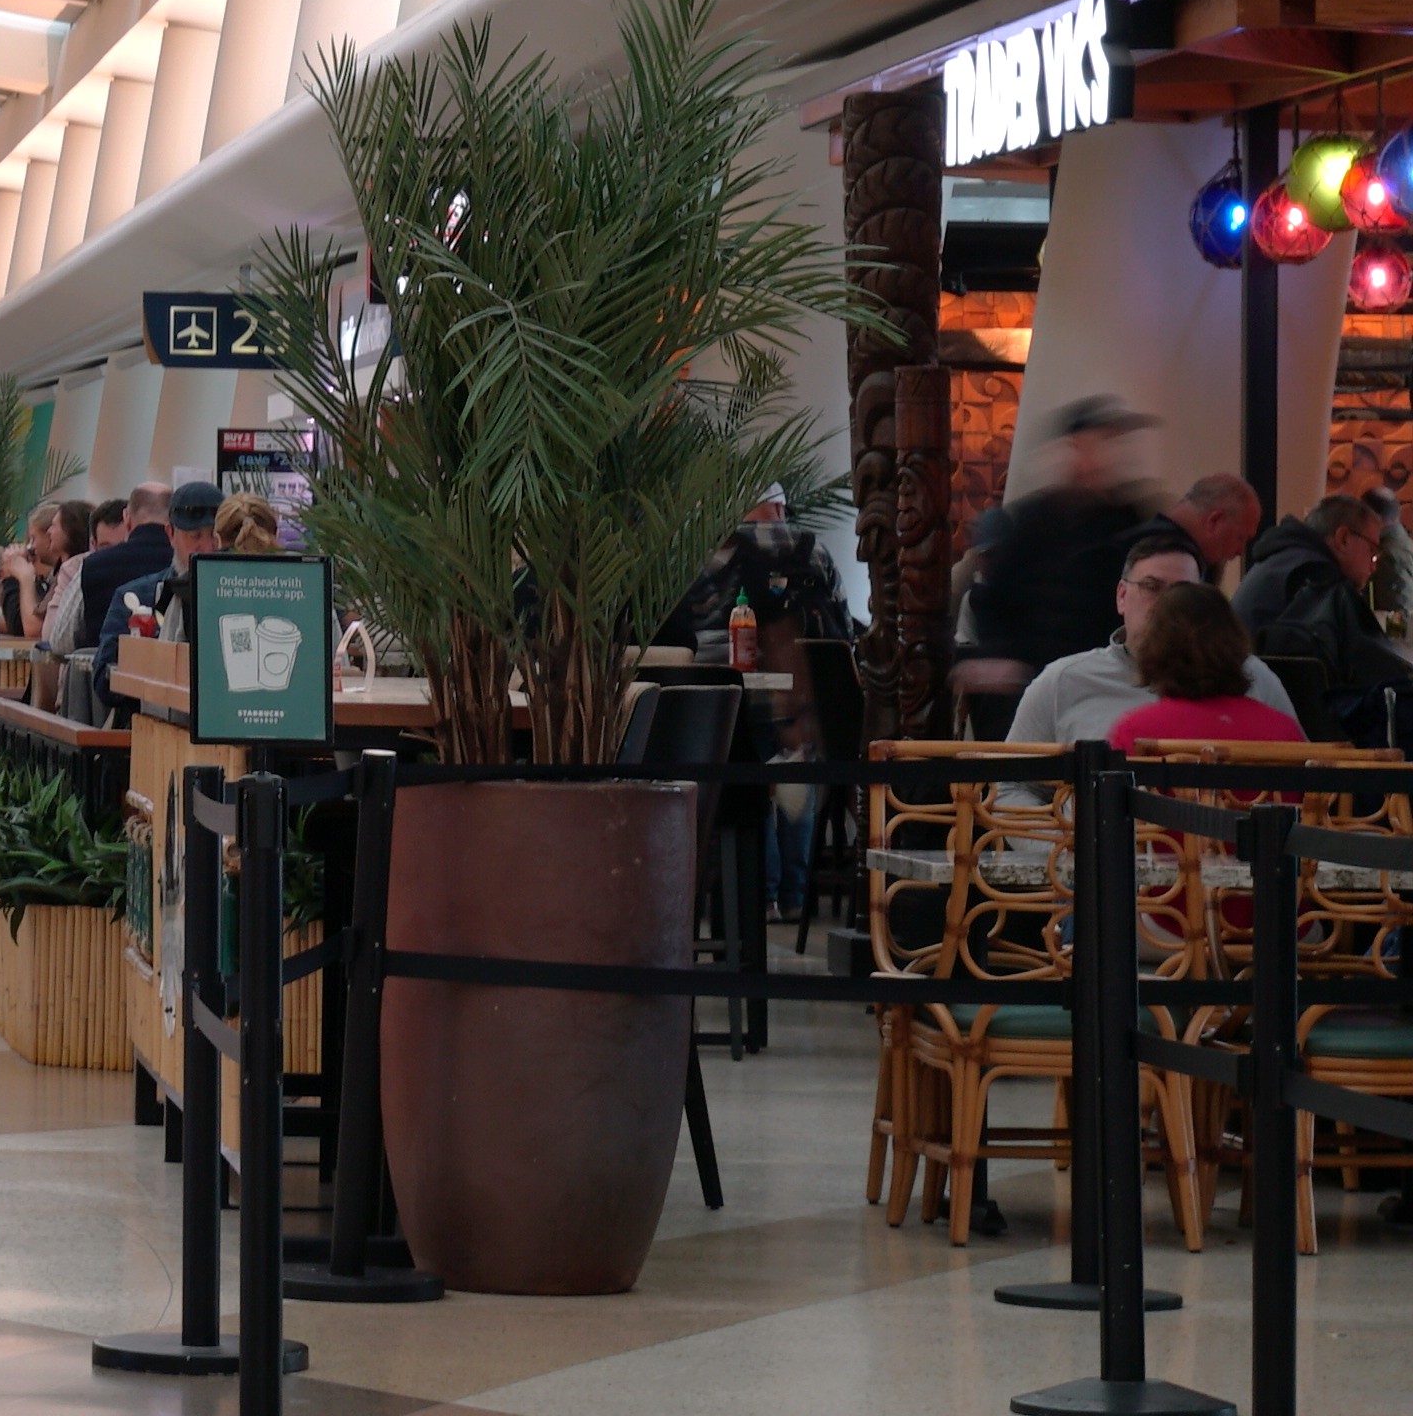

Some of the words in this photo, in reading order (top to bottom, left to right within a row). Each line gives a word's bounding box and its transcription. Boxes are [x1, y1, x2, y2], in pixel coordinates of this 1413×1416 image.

[943, 26, 1041, 168] TRADER
[219, 575, 247, 587] Order
[248, 576, 278, 588] ahead
[279, 577, 302, 589] with
[216, 586, 233, 598] the
[233, 587, 281, 599] Starbucks
[284, 590, 306, 602] app.
